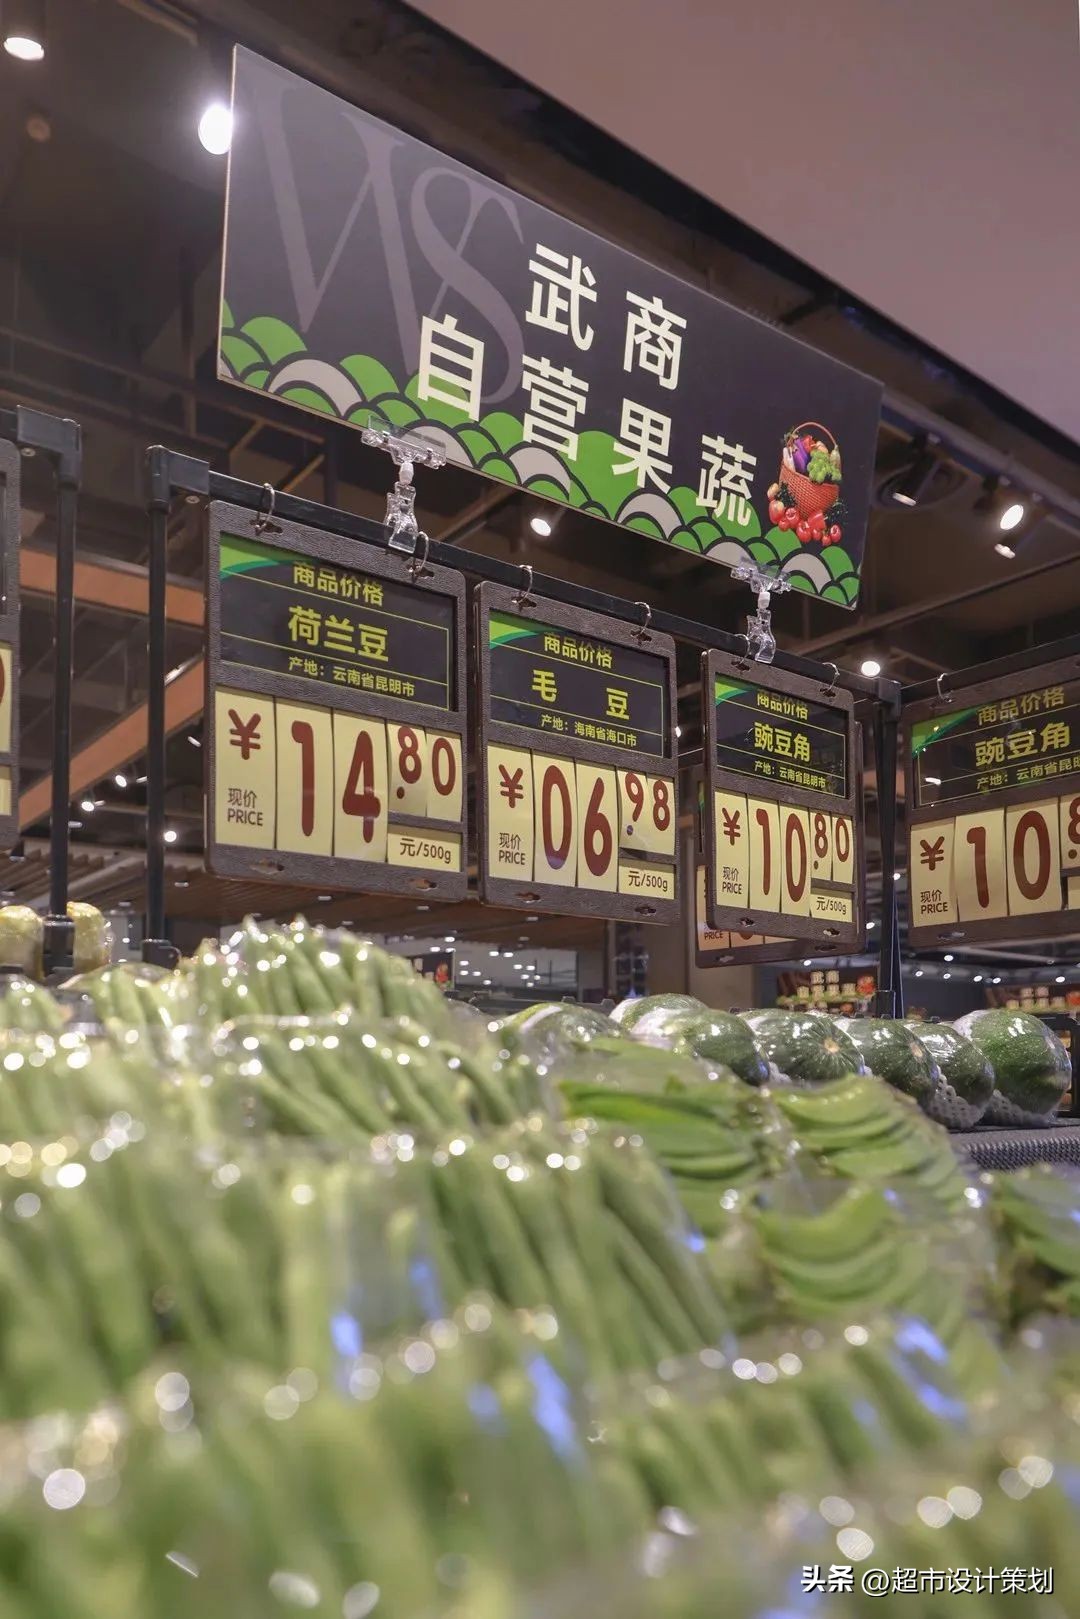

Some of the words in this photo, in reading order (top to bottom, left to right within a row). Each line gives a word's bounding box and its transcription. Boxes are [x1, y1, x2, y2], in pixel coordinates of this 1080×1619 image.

[525, 242, 687, 390] 武商
[416, 313, 757, 527] 自营果蔬
[293, 561, 384, 607] 商品价格
[288, 606, 389, 662] 荷兰豆
[544, 632, 612, 669] 商品价格
[757, 688, 808, 720] 商品价格
[977, 687, 1065, 726] 商品价格
[754, 722, 811, 762] 豌豆角
[975, 722, 1070, 767] 豌豆角
[227, 787, 258, 809] 现价
[226, 807, 264, 827] PRICE
[400, 837, 452, 864] 元/500g
[499, 833, 521, 851] 现价
[499, 849, 526, 866] PRICE
[628, 869, 668, 892] 元/500g
[723, 866, 739, 882] 现价
[722, 881, 742, 895] PRICE
[920, 889, 942, 903] 现价
[816, 896, 847, 915] 元/500g
[920, 901, 948, 915] PRICE
